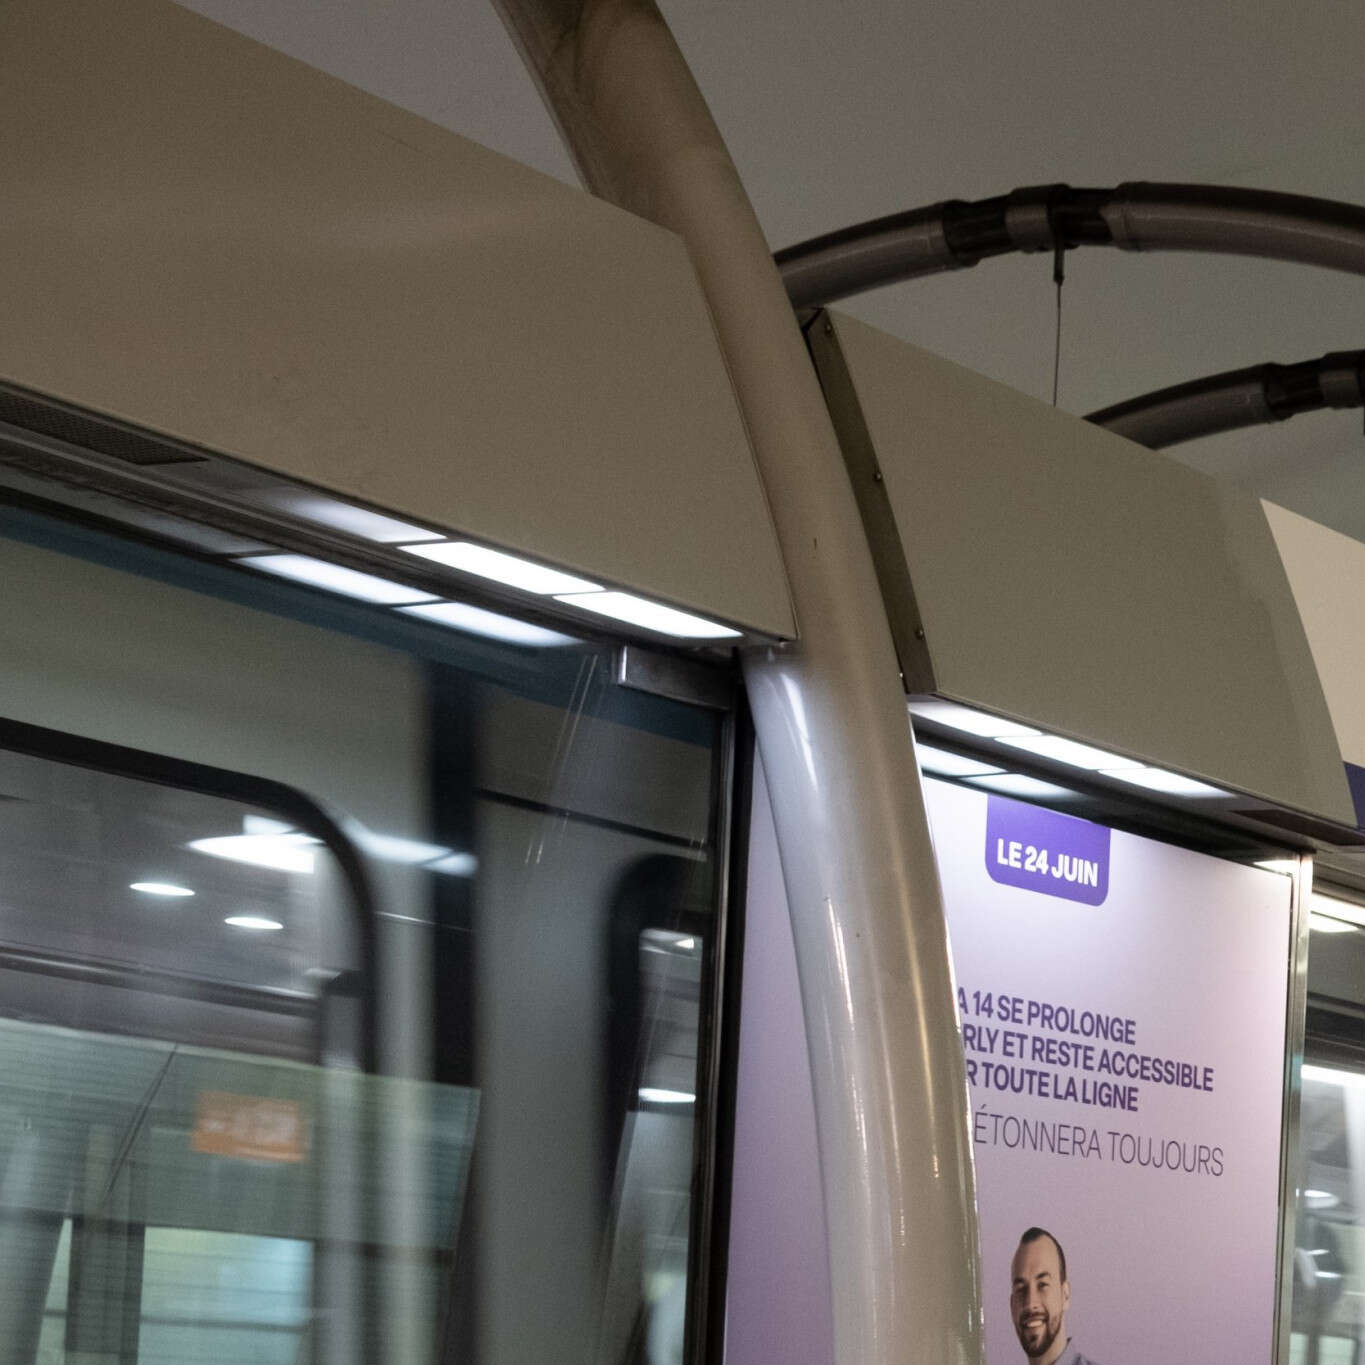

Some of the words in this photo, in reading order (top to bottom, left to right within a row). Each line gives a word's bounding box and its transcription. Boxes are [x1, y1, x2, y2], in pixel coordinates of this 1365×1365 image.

[996, 837, 1023, 869] LE
[1024, 844, 1050, 875] 24
[1051, 853, 1099, 888] JUIN
[957, 986, 969, 1015] A
[973, 990, 994, 1019] 14
[997, 994, 1025, 1025] SE
[1027, 1000, 1137, 1046] PROLONGE
[963, 1022, 999, 1054] RLY
[1002, 1029, 1029, 1059] ET
[1031, 1035, 1096, 1072] RESTE
[1097, 1048, 1215, 1093] ACCESSIBLE
[981, 1061, 1051, 1098] TOUTE
[1053, 1073, 1079, 1102] LA
[1081, 1078, 1140, 1112] LIGNE
[973, 1102, 1102, 1161] ÉTONNERA
[1107, 1130, 1225, 1178] TOUJOURS
